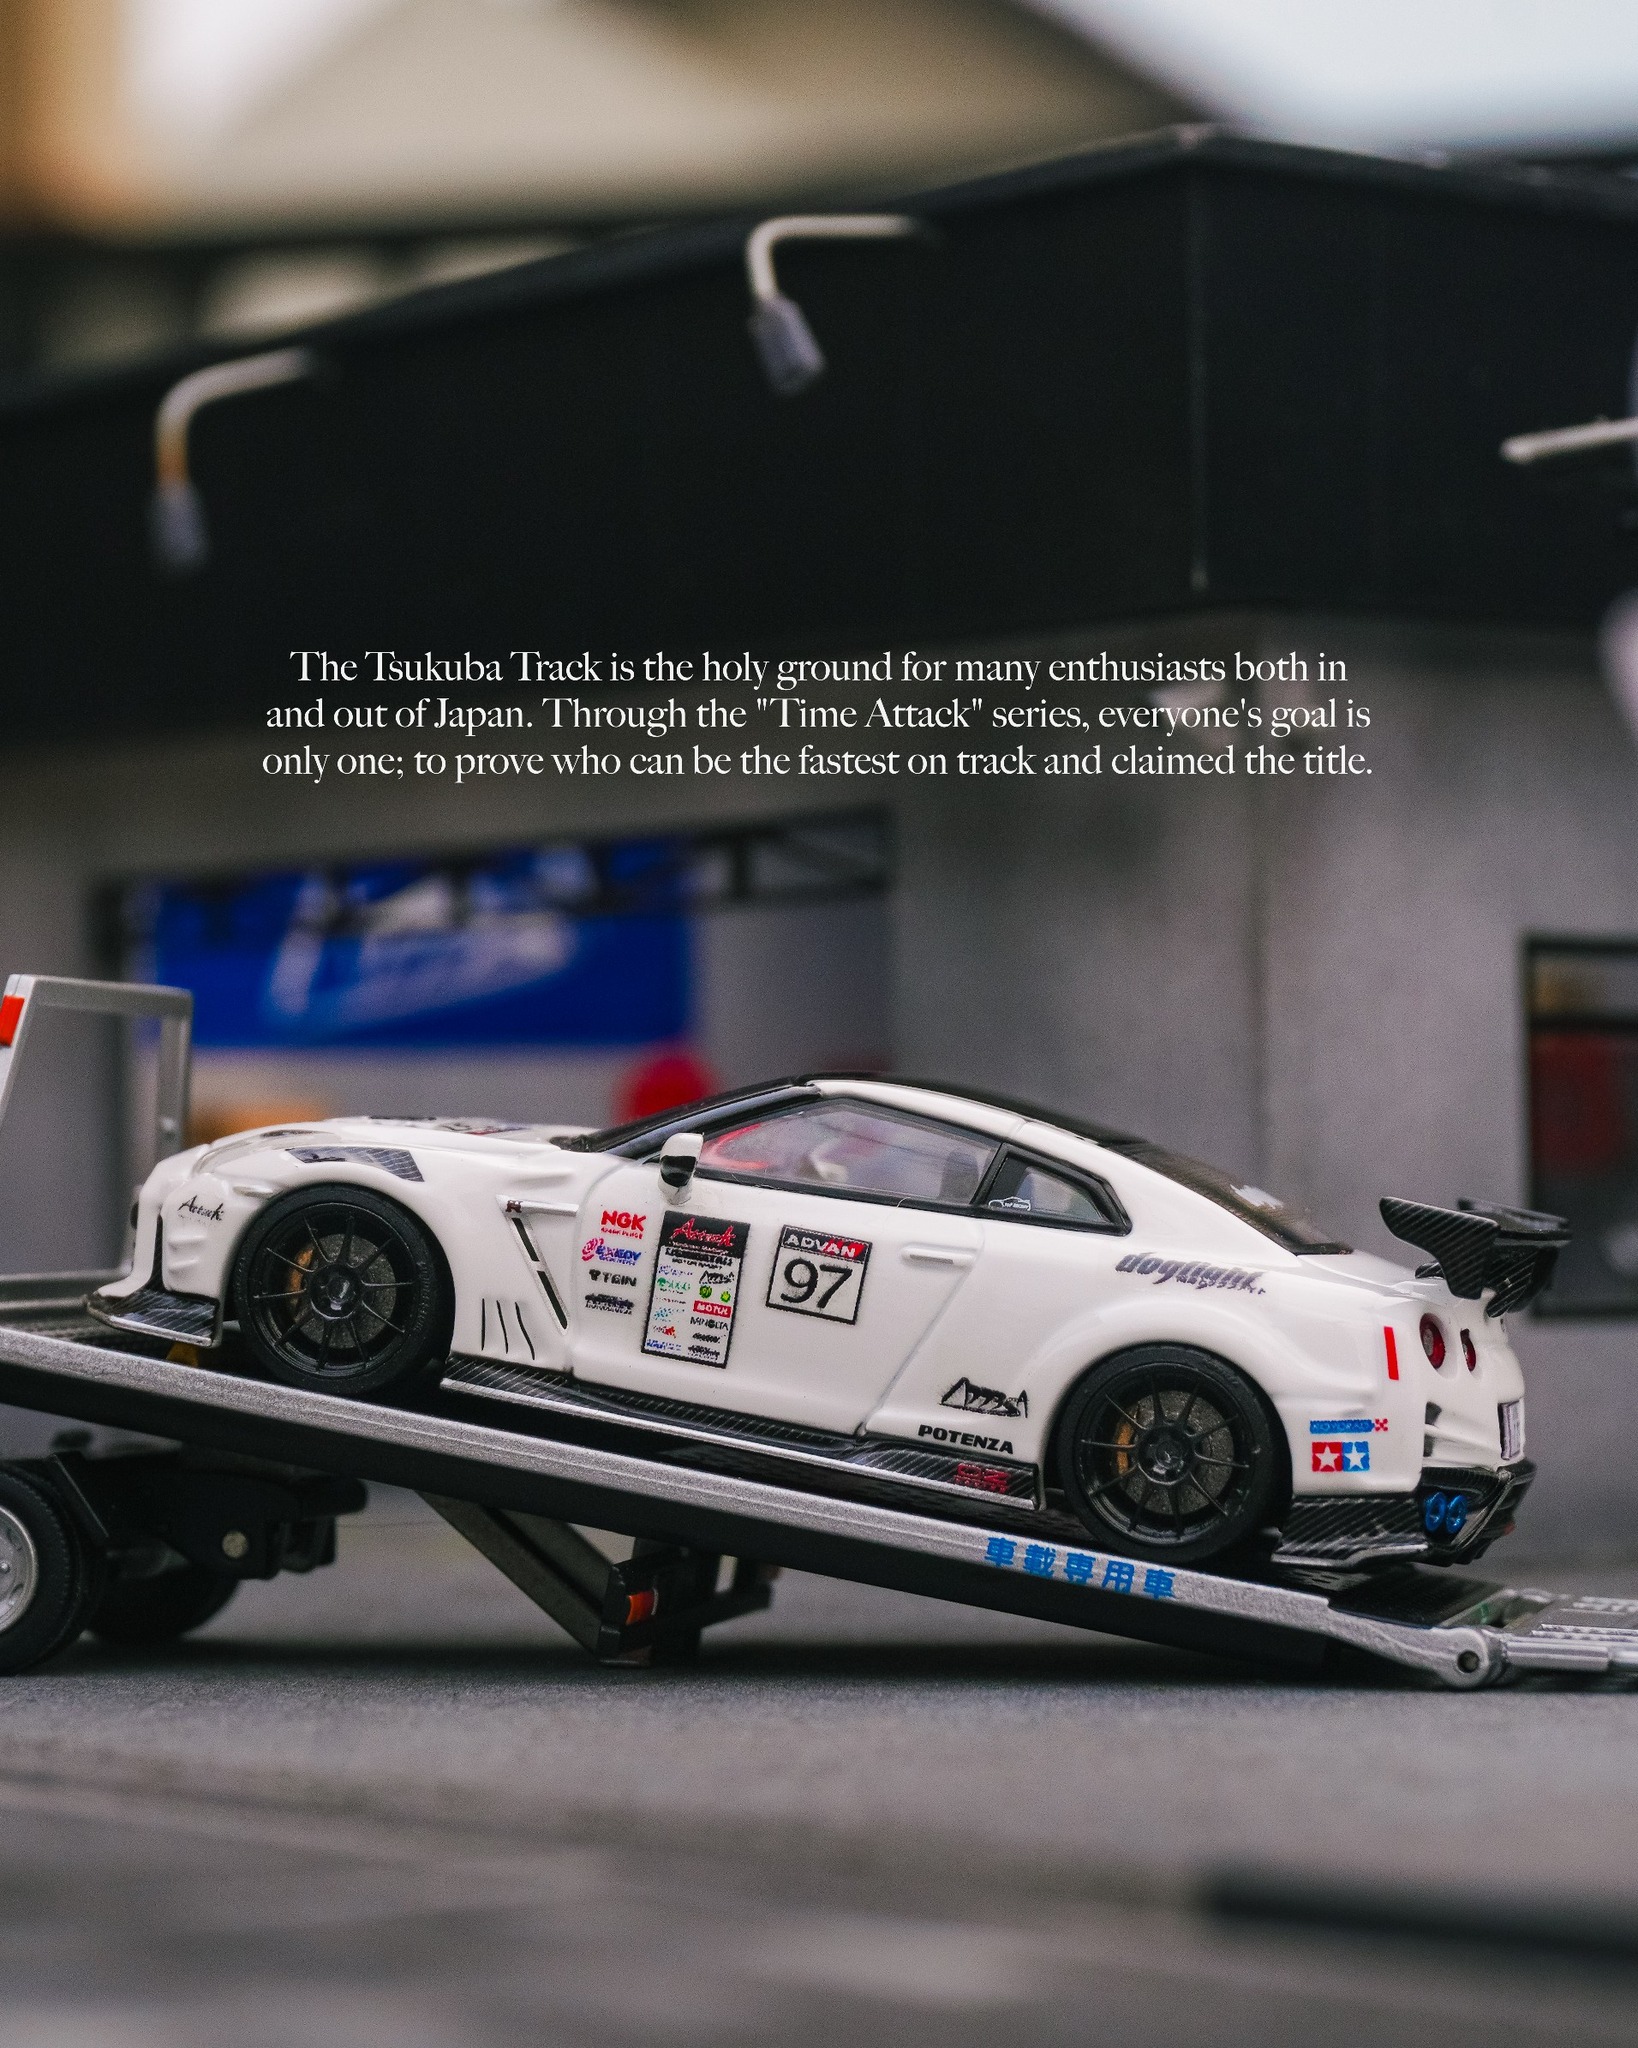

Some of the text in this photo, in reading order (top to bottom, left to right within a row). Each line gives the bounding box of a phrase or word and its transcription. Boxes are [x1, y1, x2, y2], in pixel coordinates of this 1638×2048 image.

[600, 1210, 647, 1232] NGK
[783, 1233, 857, 1259] ADVAN
[780, 1258, 853, 1309] 97
[917, 1423, 1014, 1455] POTENZA
